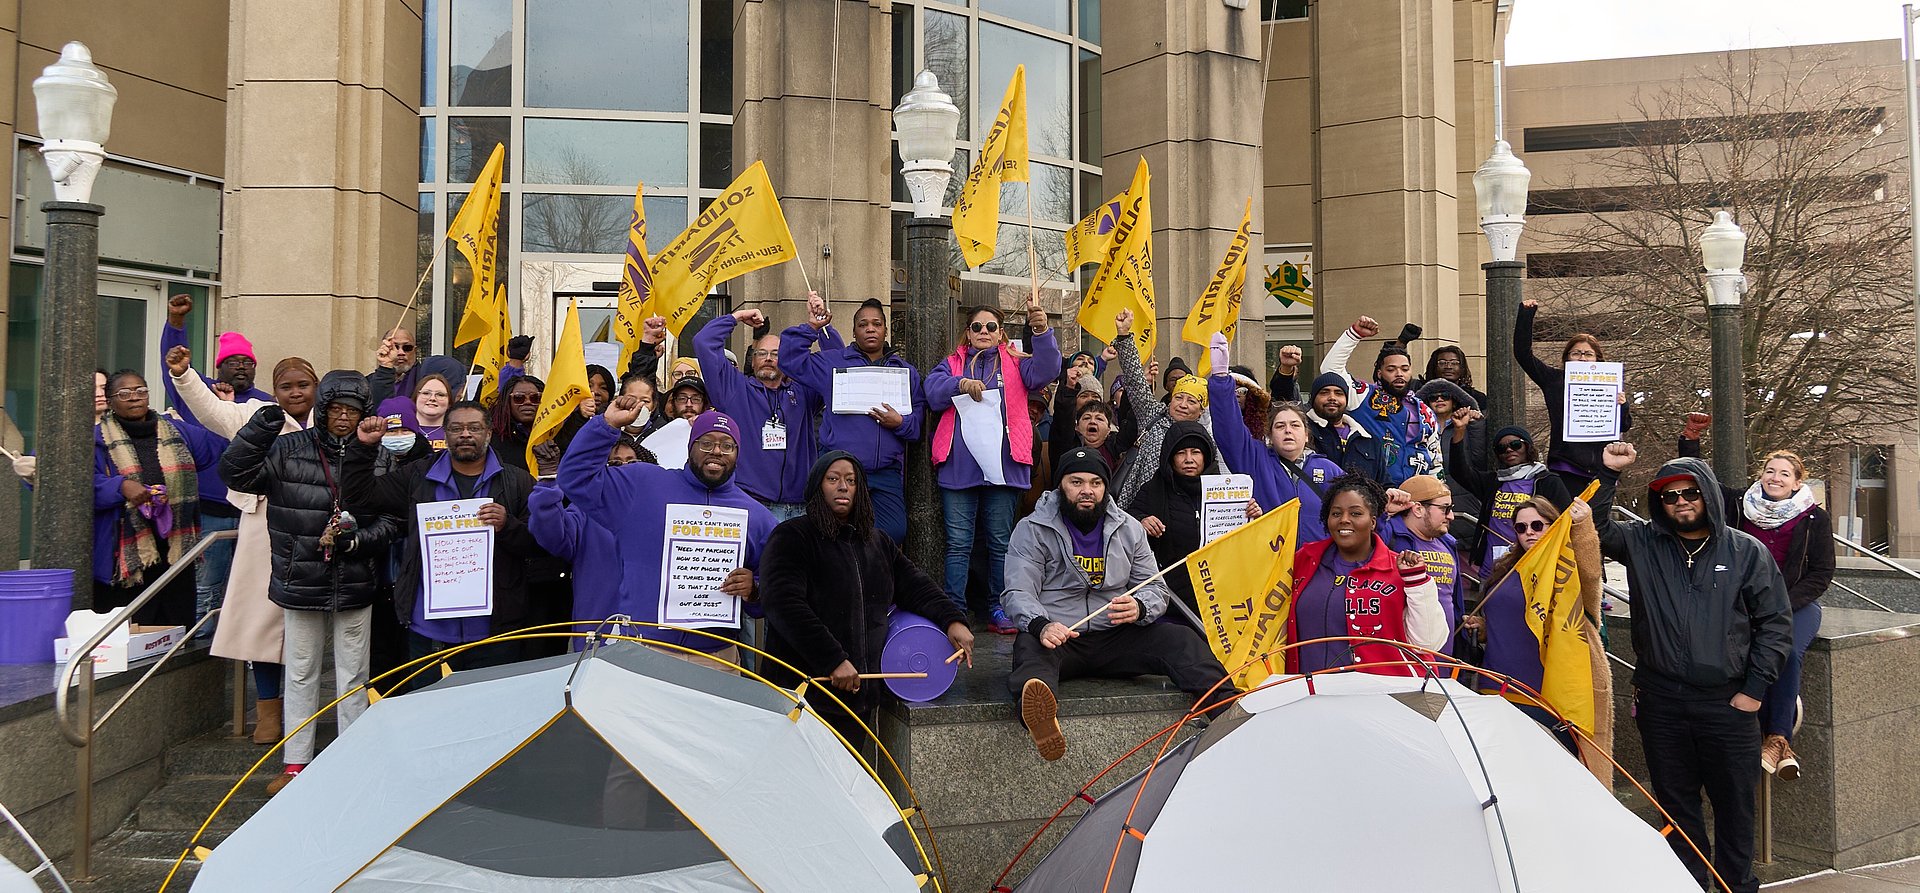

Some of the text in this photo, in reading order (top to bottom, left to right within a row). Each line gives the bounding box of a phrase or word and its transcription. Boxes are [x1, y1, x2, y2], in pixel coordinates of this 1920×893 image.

[623, 321, 636, 340] For
[1592, 375, 1618, 383] FREE
[1206, 491, 1251, 500] FOR FREE
[425, 520, 453, 531] FOR
[672, 525, 741, 539] FOR FREE
[1198, 559, 1232, 655] SEIU Health
